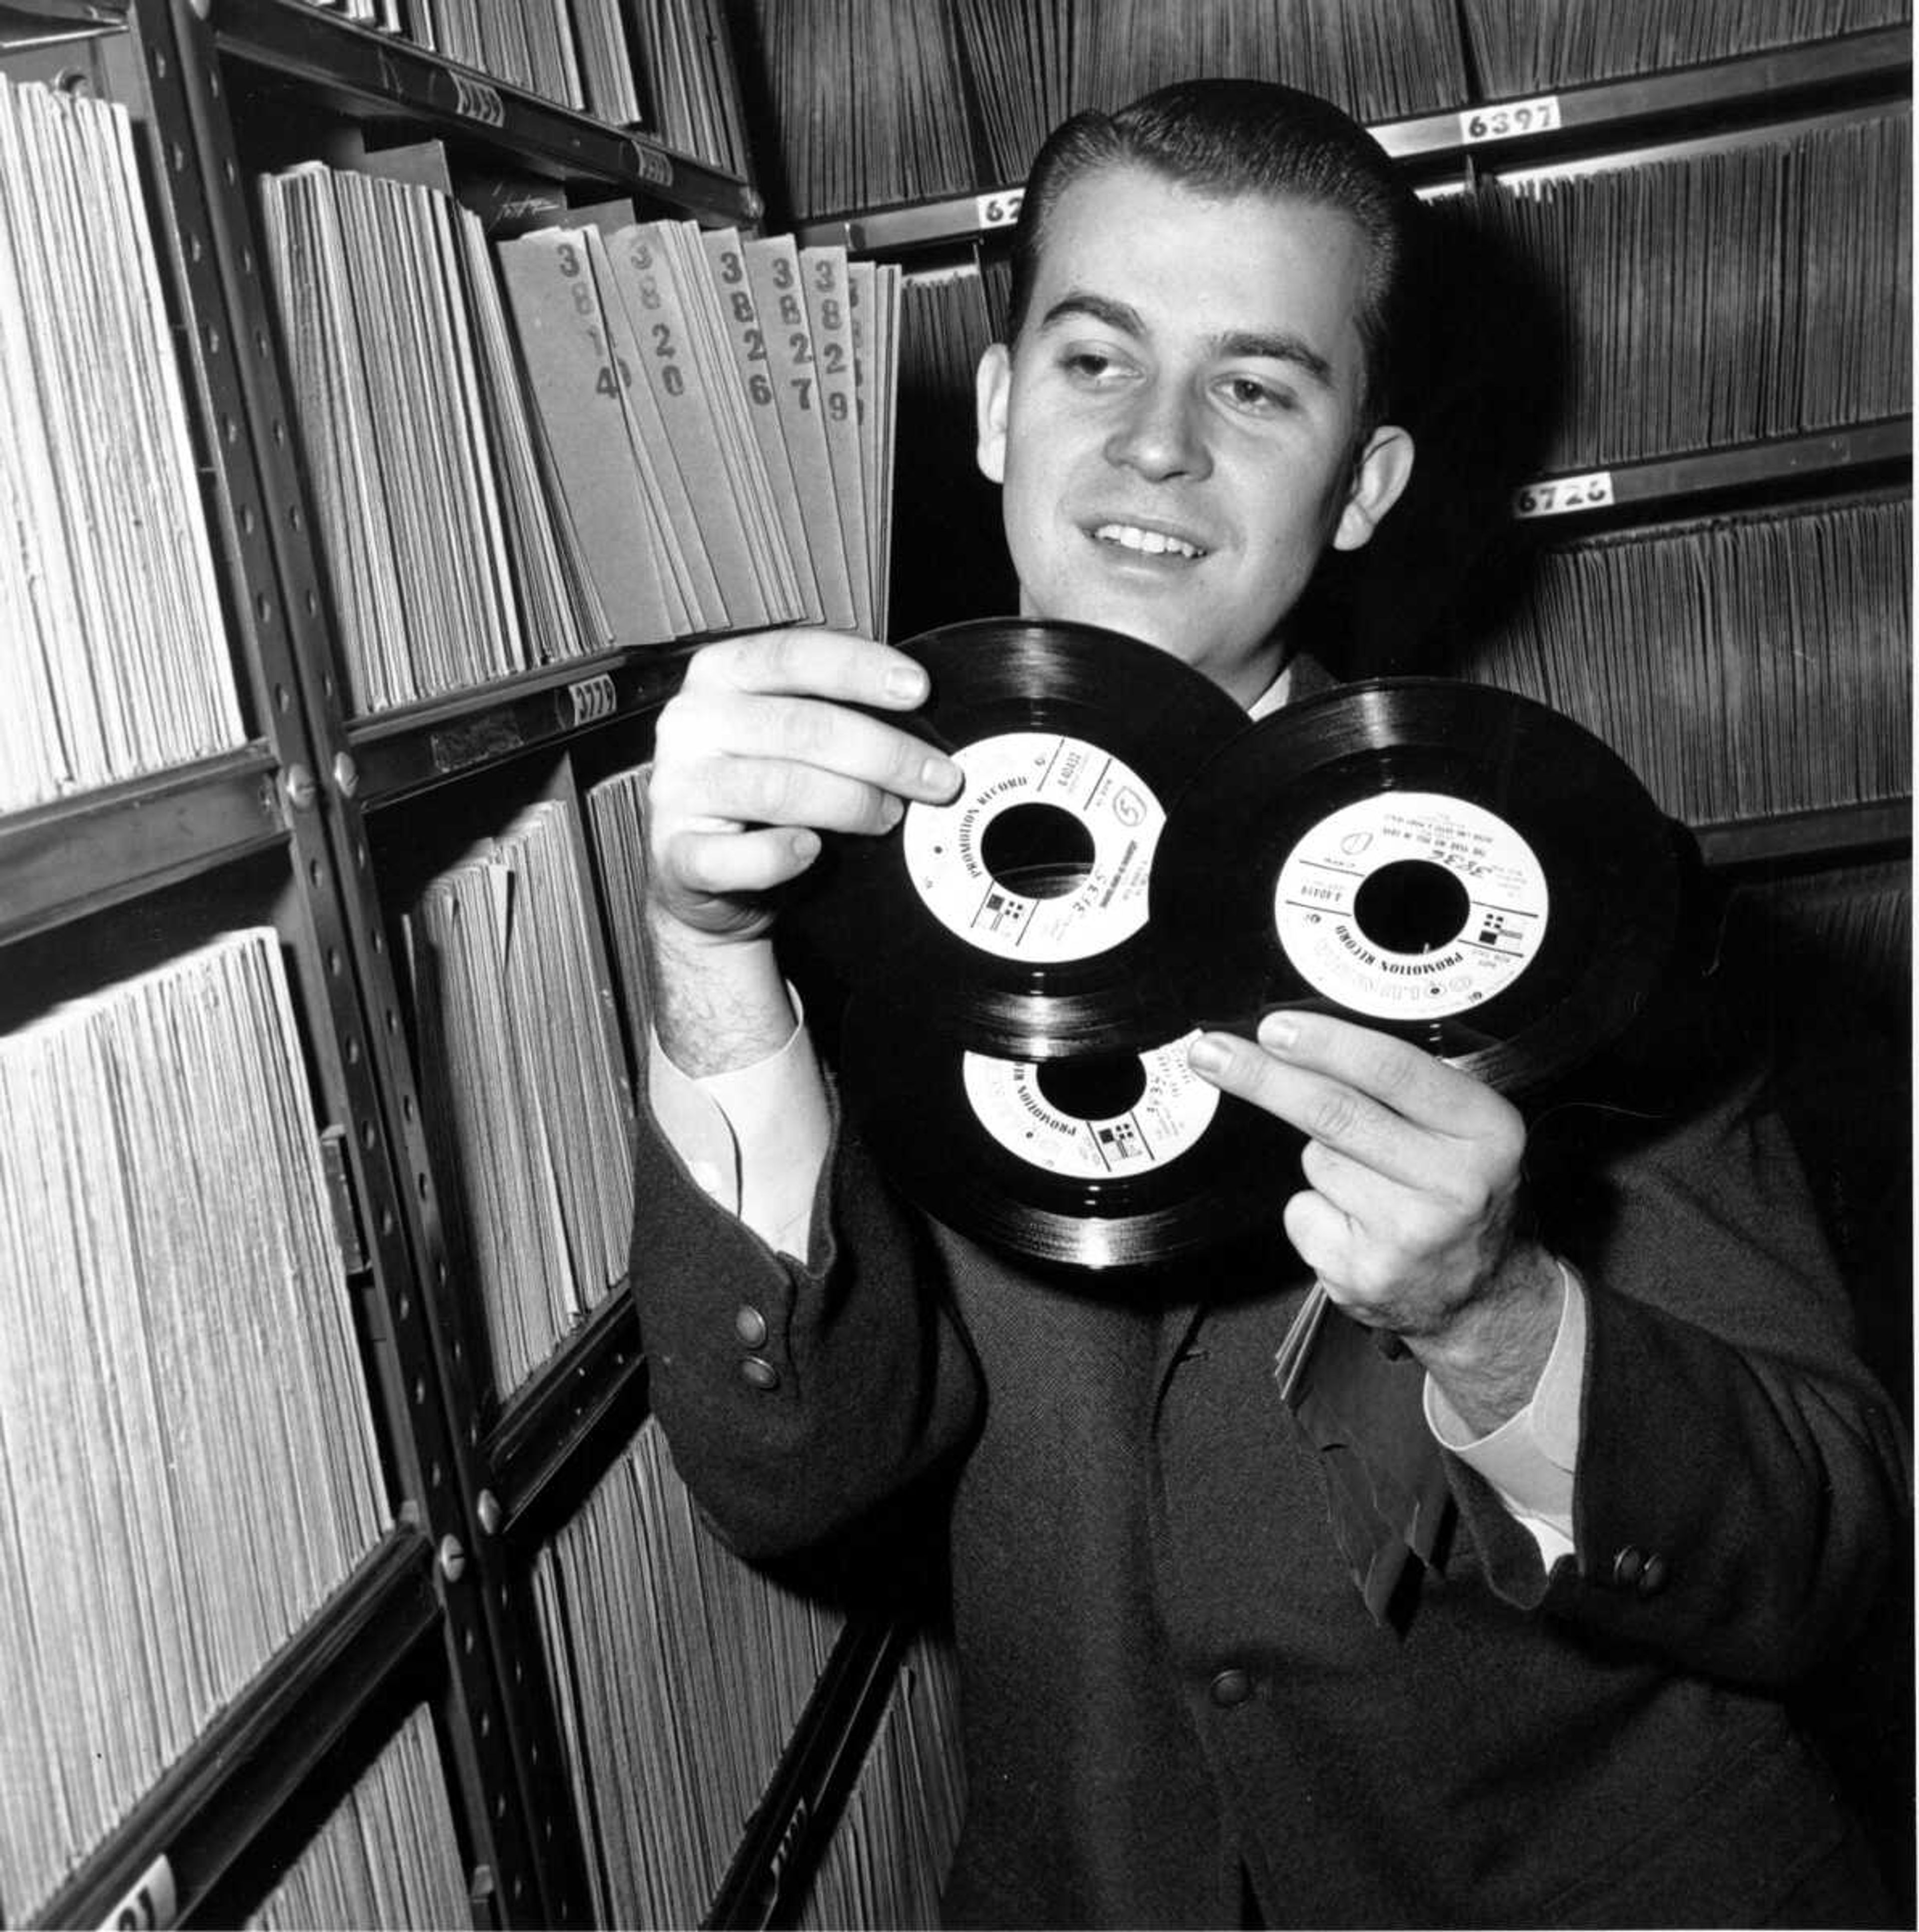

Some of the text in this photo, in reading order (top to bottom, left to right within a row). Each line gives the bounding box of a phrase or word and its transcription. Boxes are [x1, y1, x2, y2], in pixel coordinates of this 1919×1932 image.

[1469, 106, 1551, 138] 6397
[630, 244, 684, 397] 3820
[721, 251, 772, 406] 3826
[772, 257, 813, 411] 3827
[815, 260, 849, 422] 3829
[959, 775, 1028, 879] PROMOTION RECORD
[1335, 925, 1376, 965] RECORD
[1381, 951, 1464, 975] PROMOTION
[1016, 1084, 1077, 1137] PROMOTION
